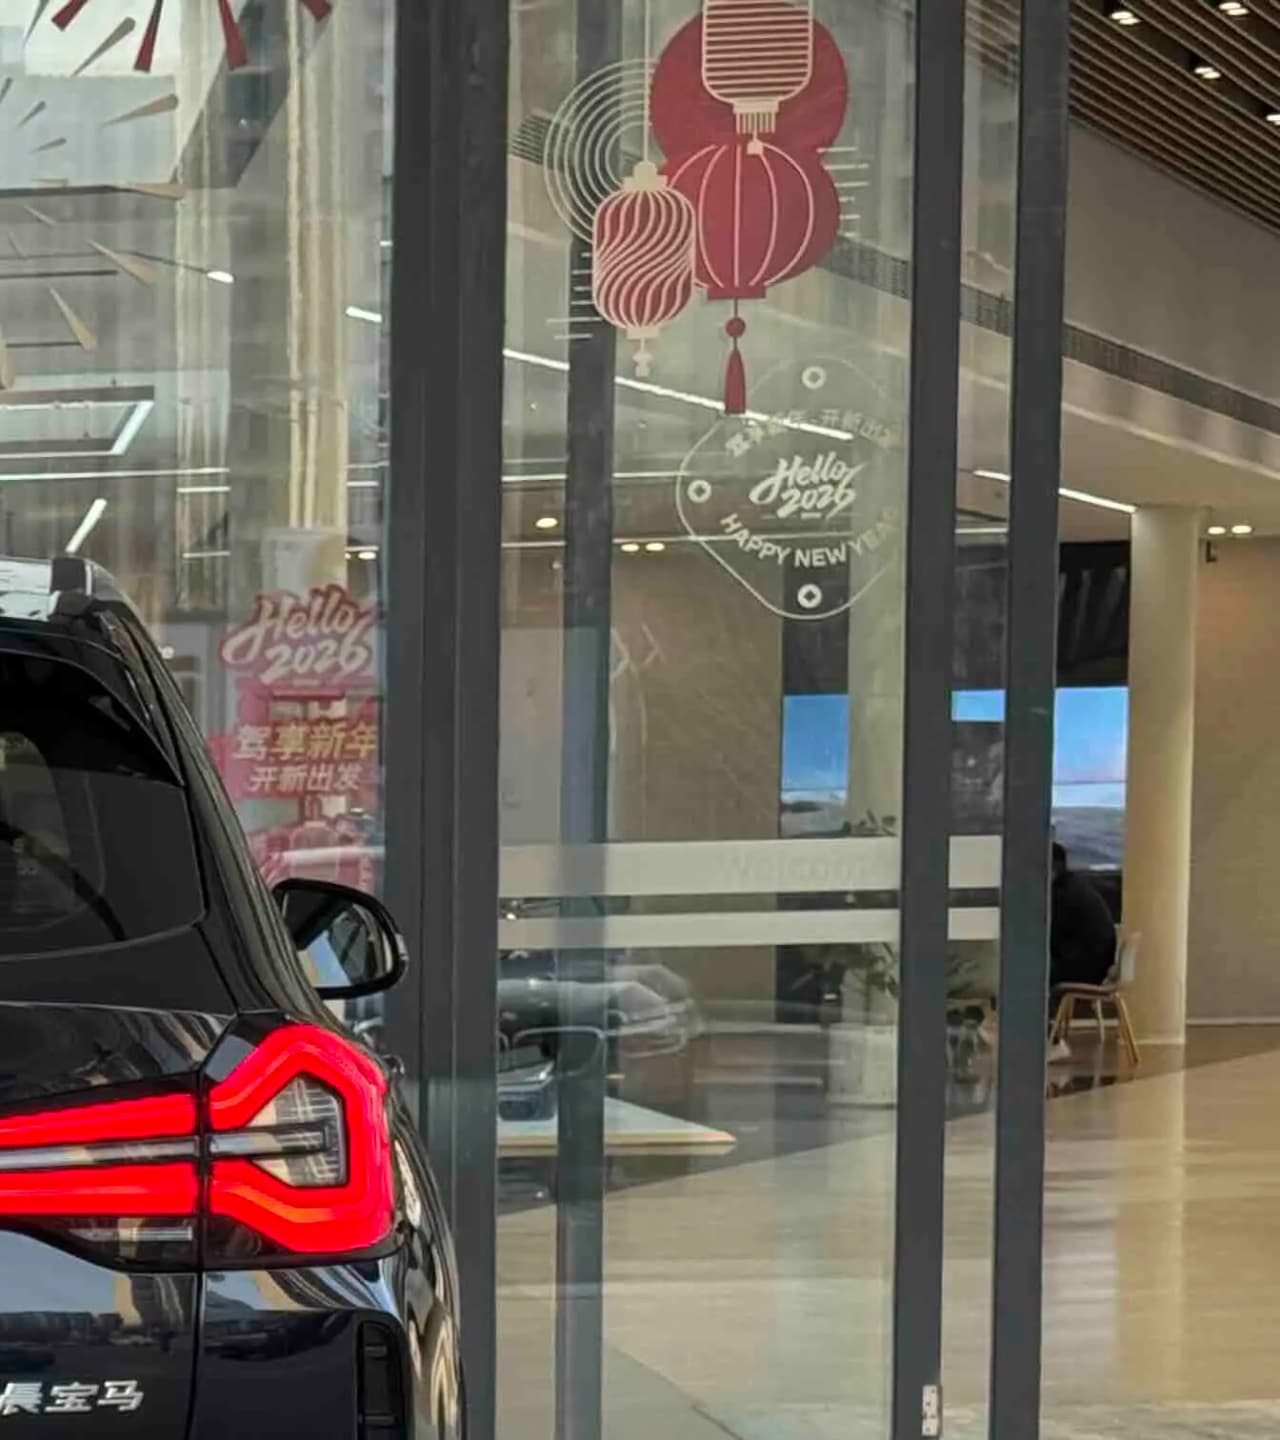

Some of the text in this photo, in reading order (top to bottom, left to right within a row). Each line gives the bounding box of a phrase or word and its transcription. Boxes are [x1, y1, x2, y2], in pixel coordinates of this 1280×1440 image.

[749, 451, 849, 505] Hello
[776, 469, 864, 519] 2026
[720, 512, 790, 565] HAPPY
[794, 545, 847, 568] NEW
[222, 594, 354, 665] Hello
[261, 612, 370, 684] 2026
